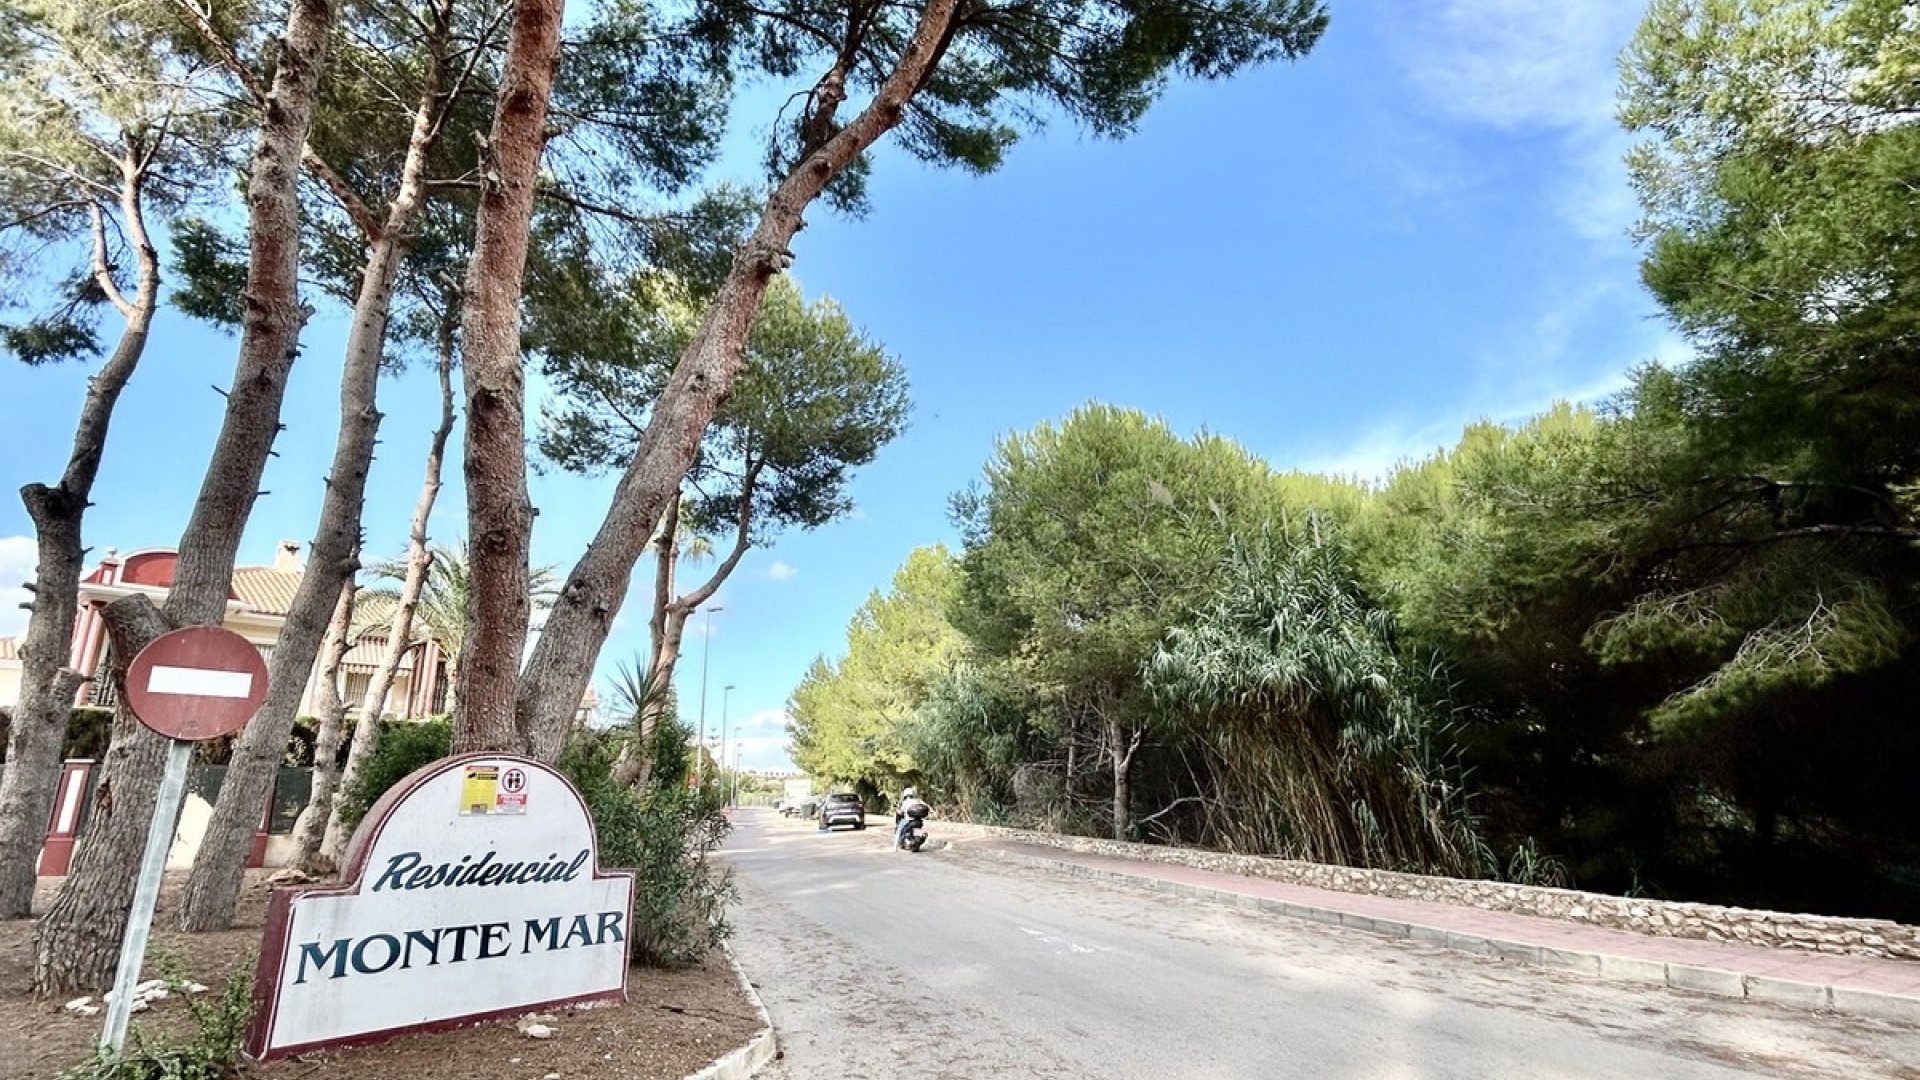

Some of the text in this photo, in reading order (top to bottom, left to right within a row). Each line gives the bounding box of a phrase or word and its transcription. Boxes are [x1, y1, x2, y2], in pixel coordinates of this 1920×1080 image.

[372, 849, 590, 892] Residencial
[293, 910, 624, 985] MONTE MAR
